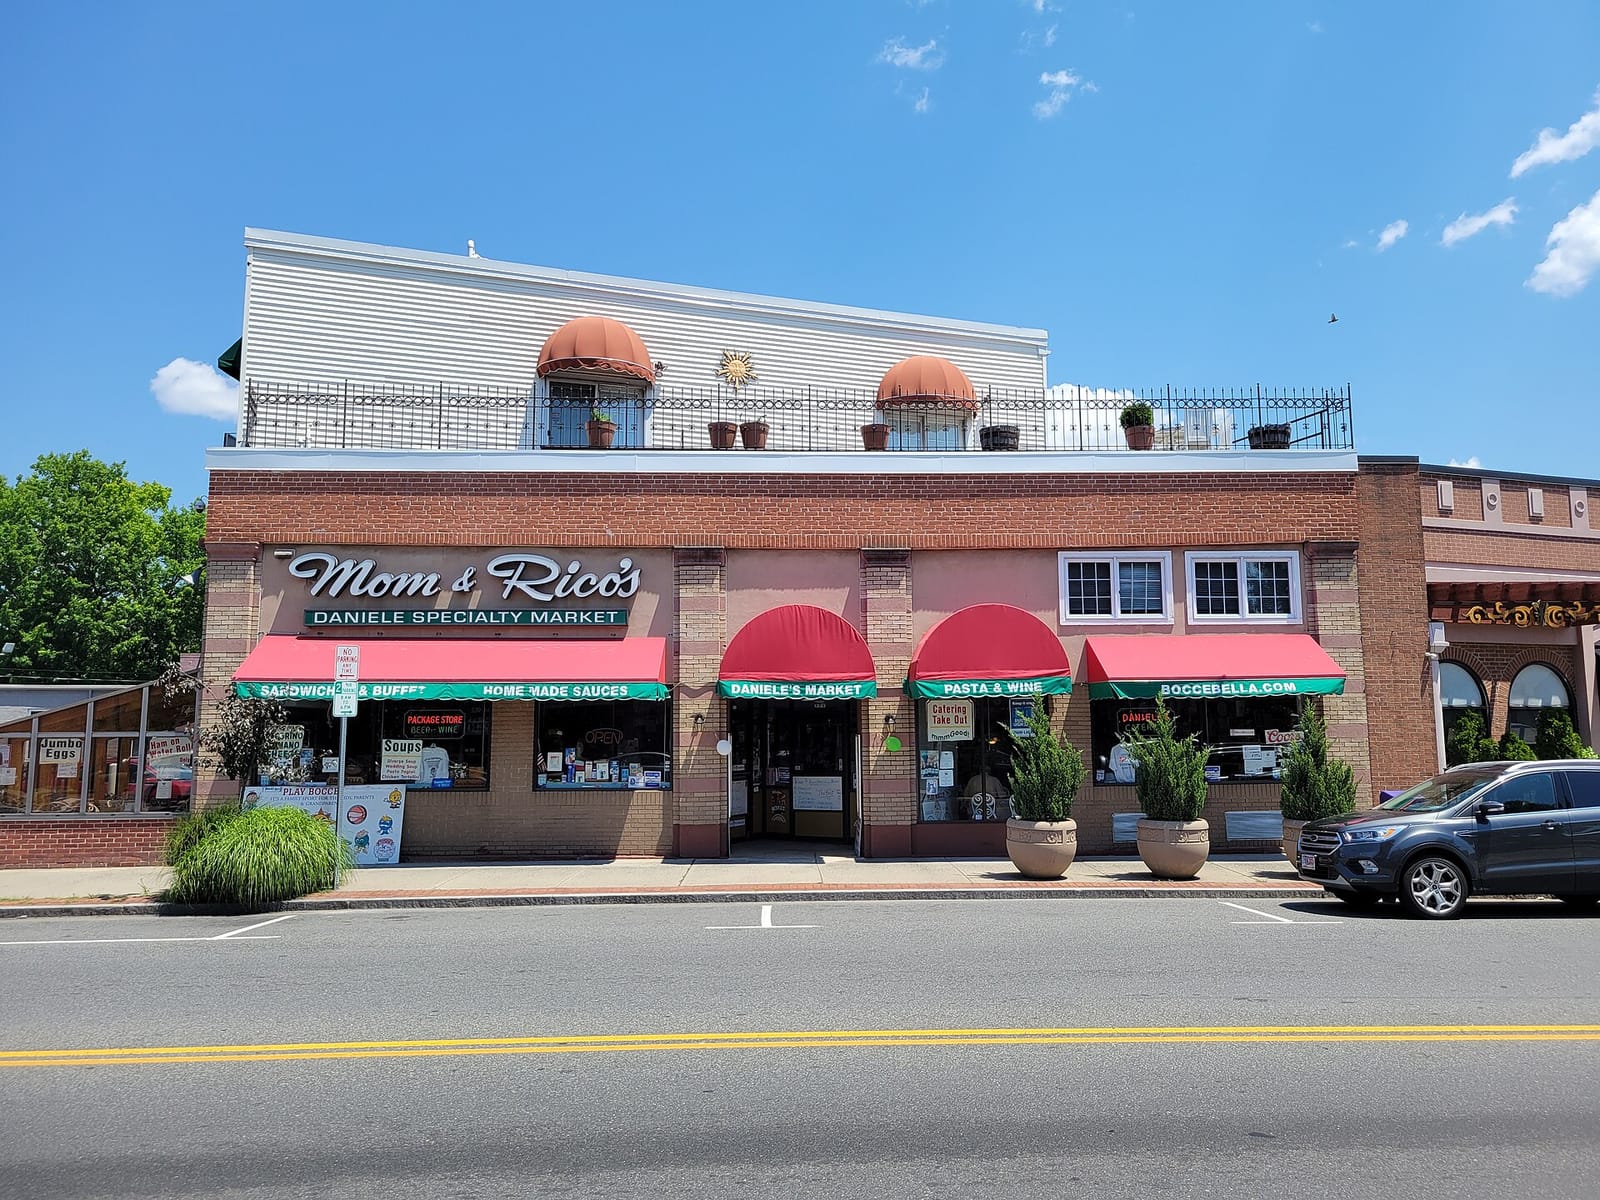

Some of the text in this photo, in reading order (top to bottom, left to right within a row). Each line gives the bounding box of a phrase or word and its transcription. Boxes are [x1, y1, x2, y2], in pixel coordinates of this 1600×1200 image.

[288, 552, 641, 601] Mom & Rico's
[314, 611, 619, 624] DANIELE SPECIALTY MARKET
[261, 685, 335, 697] SANDWICH
[359, 685, 368, 697] &
[336, 682, 341, 692] 2
[483, 686, 628, 697] HOME MADE SAUCES
[731, 684, 862, 696] DANIELE'S MARKET
[944, 681, 1043, 694] PASTA & WINE
[1161, 682, 1297, 695] BOCCEBELLA.COM
[932, 704, 967, 715] Catering
[407, 715, 464, 724] PACKAGE STORE
[932, 714, 968, 724] Take Out
[410, 725, 459, 734] BEER WINE
[585, 730, 621, 744] OPEN
[41, 739, 82, 748] Jumbo
[151, 738, 180, 749] Ham on
[384, 740, 422, 754] Soups
[46, 748, 76, 759] Eggs
[283, 787, 306, 796] PLAY
